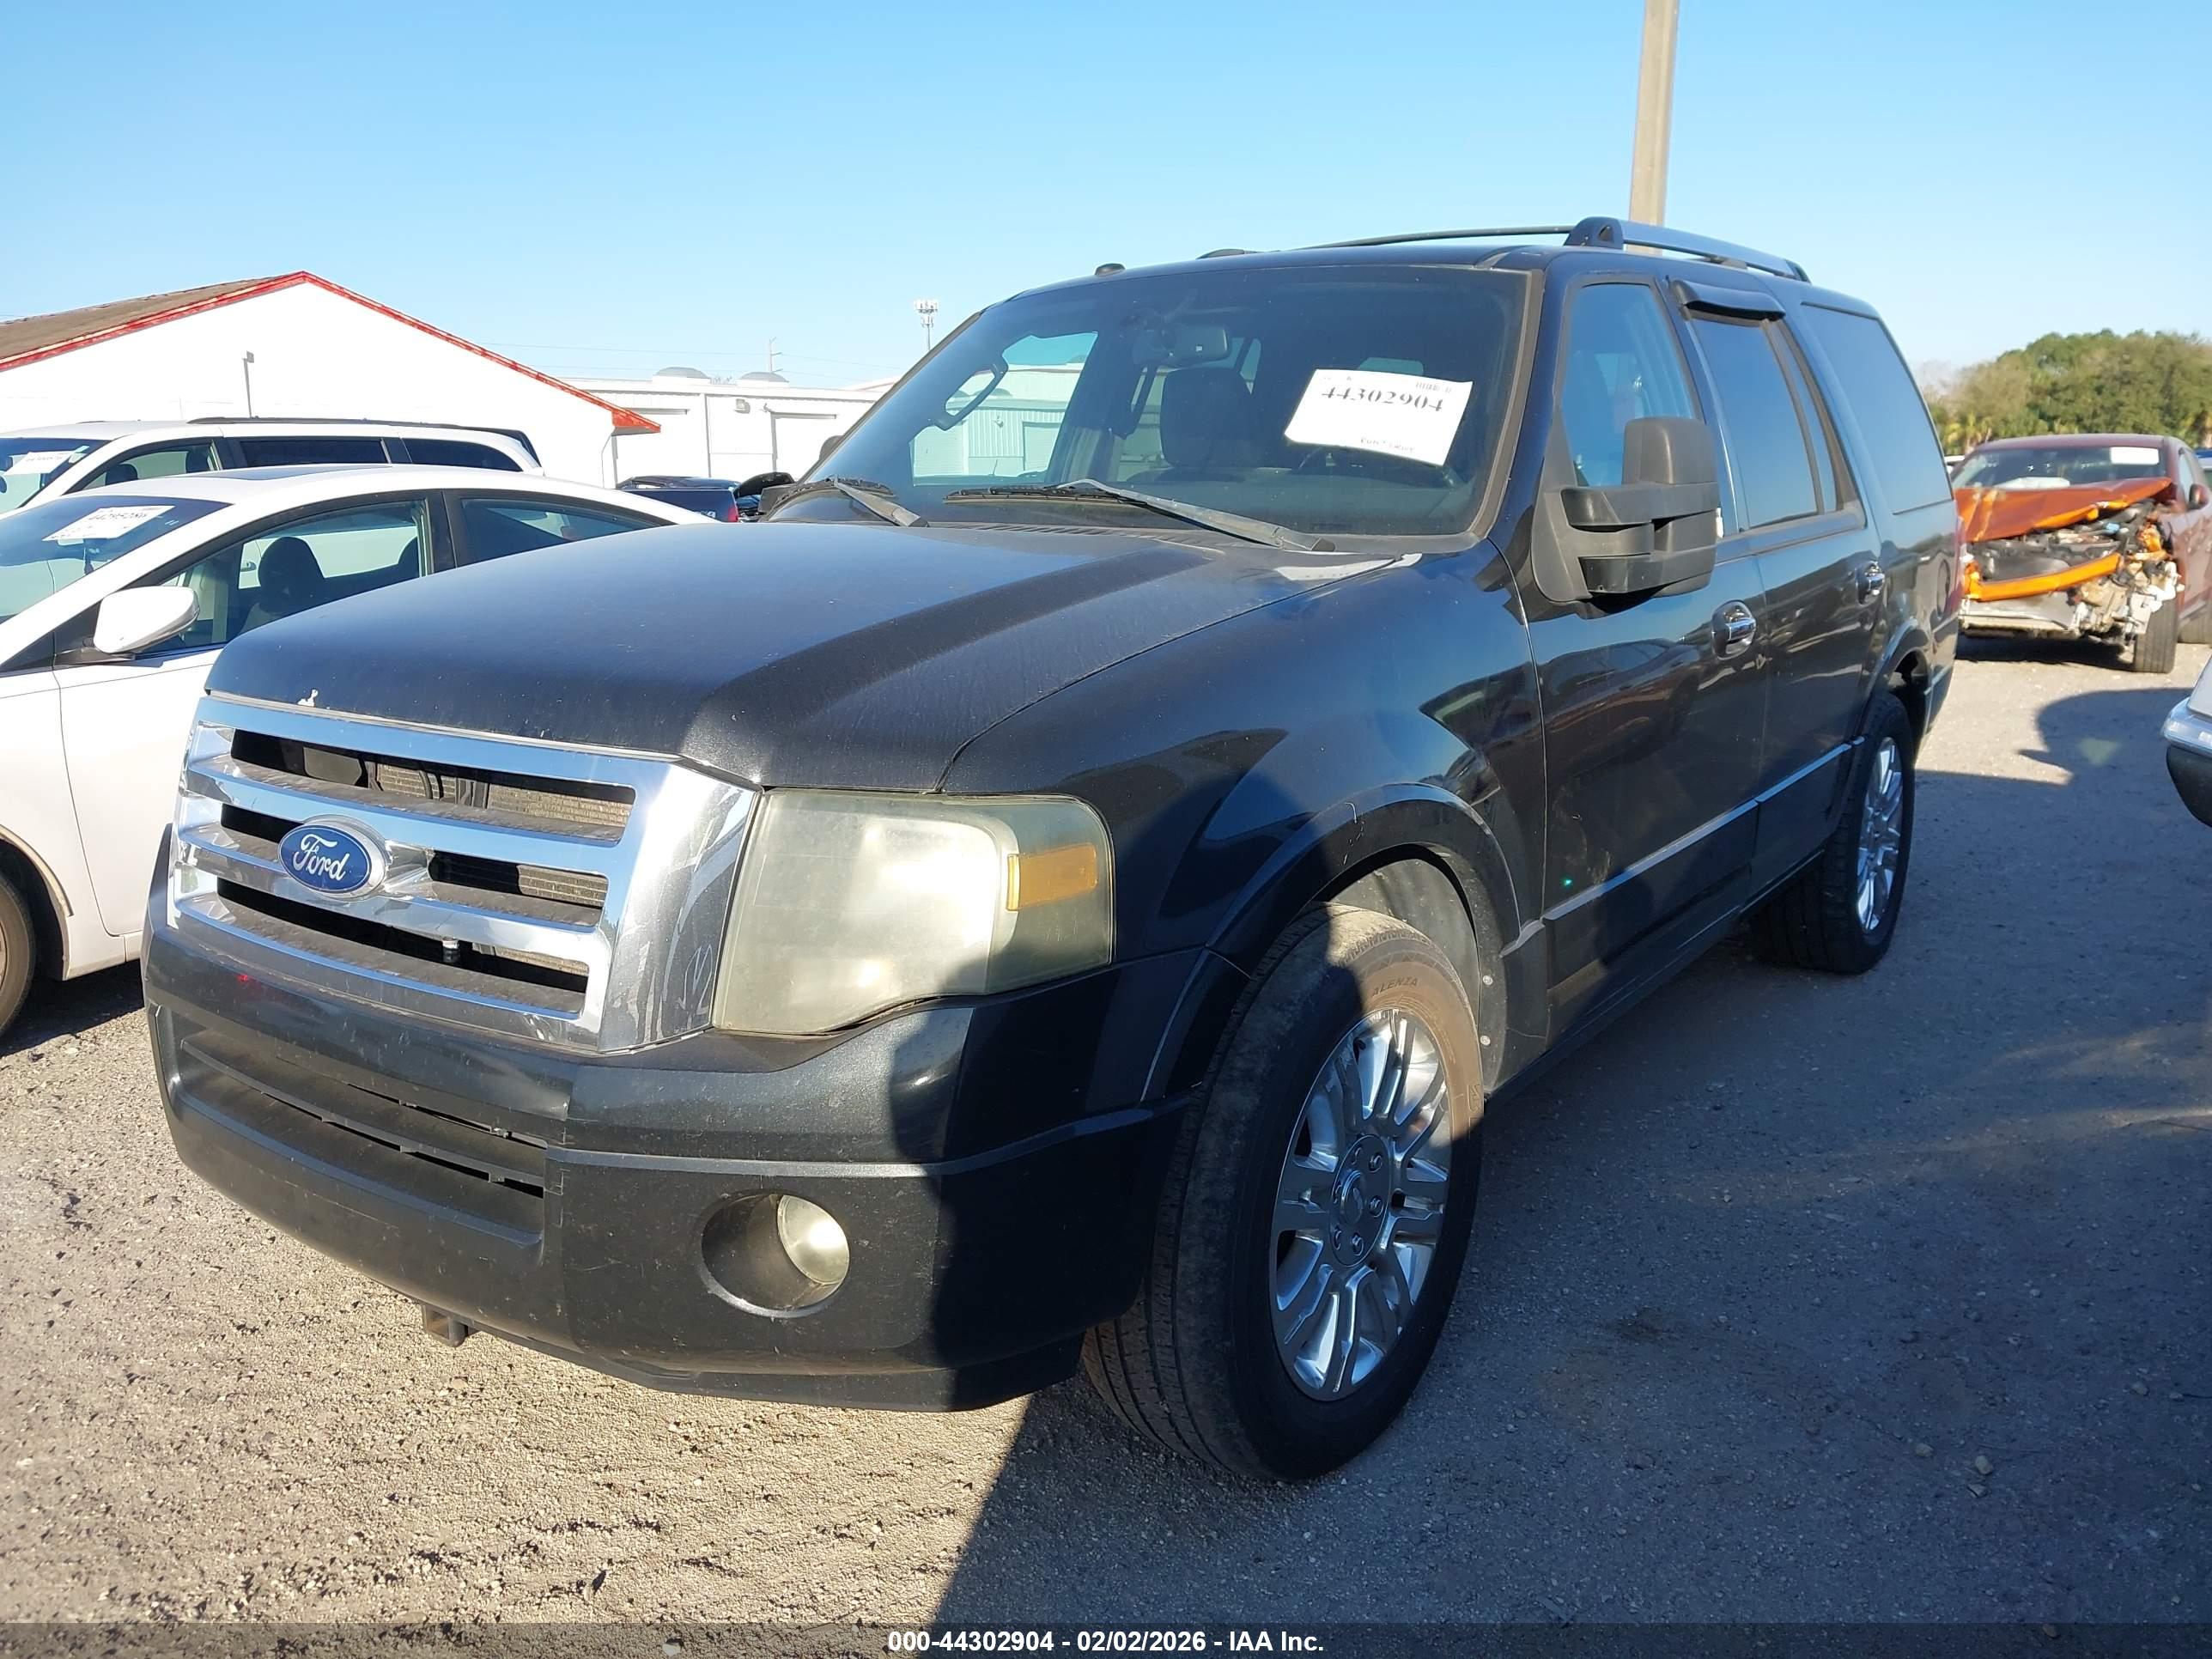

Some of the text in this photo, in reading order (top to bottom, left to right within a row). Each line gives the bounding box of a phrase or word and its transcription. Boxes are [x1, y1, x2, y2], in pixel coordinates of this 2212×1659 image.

[1322, 386, 1443, 412] 44302904
[292, 833, 350, 882] Ford
[1371, 975, 1419, 998] ALENZA
